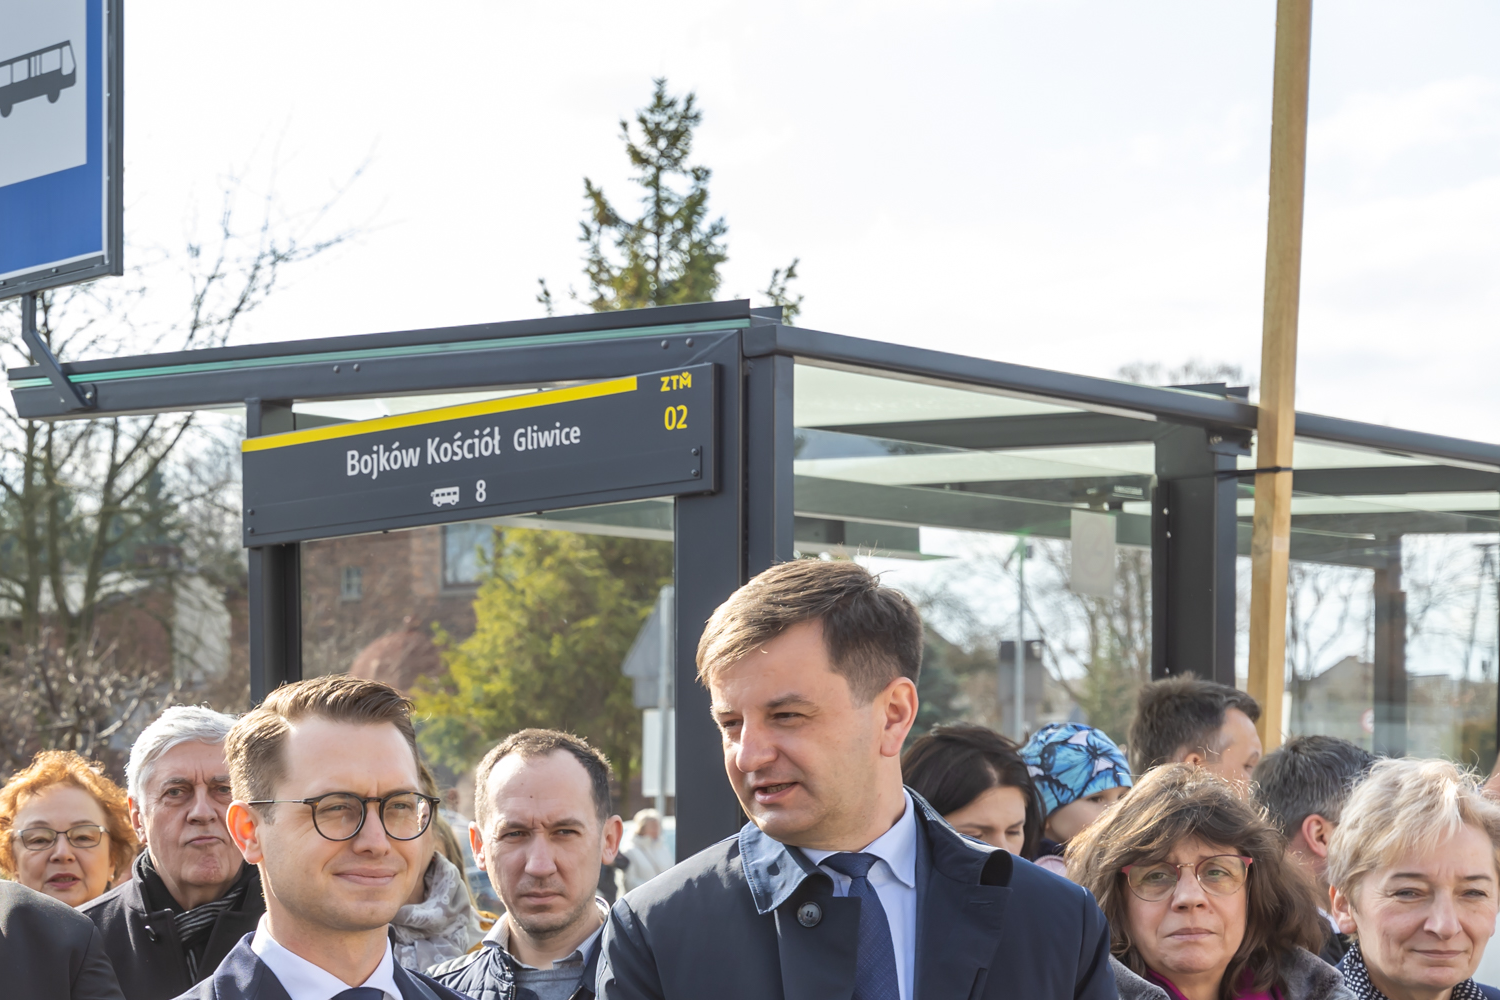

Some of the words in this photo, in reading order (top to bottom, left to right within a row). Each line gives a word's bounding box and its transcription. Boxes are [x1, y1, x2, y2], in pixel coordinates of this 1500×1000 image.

[660, 372, 692, 392] ZTM
[664, 405, 688, 430] 02
[346, 441, 421, 480] Bojków
[427, 426, 501, 465] Kościół
[513, 421, 581, 451] Gliwice
[475, 479, 487, 502] 8
